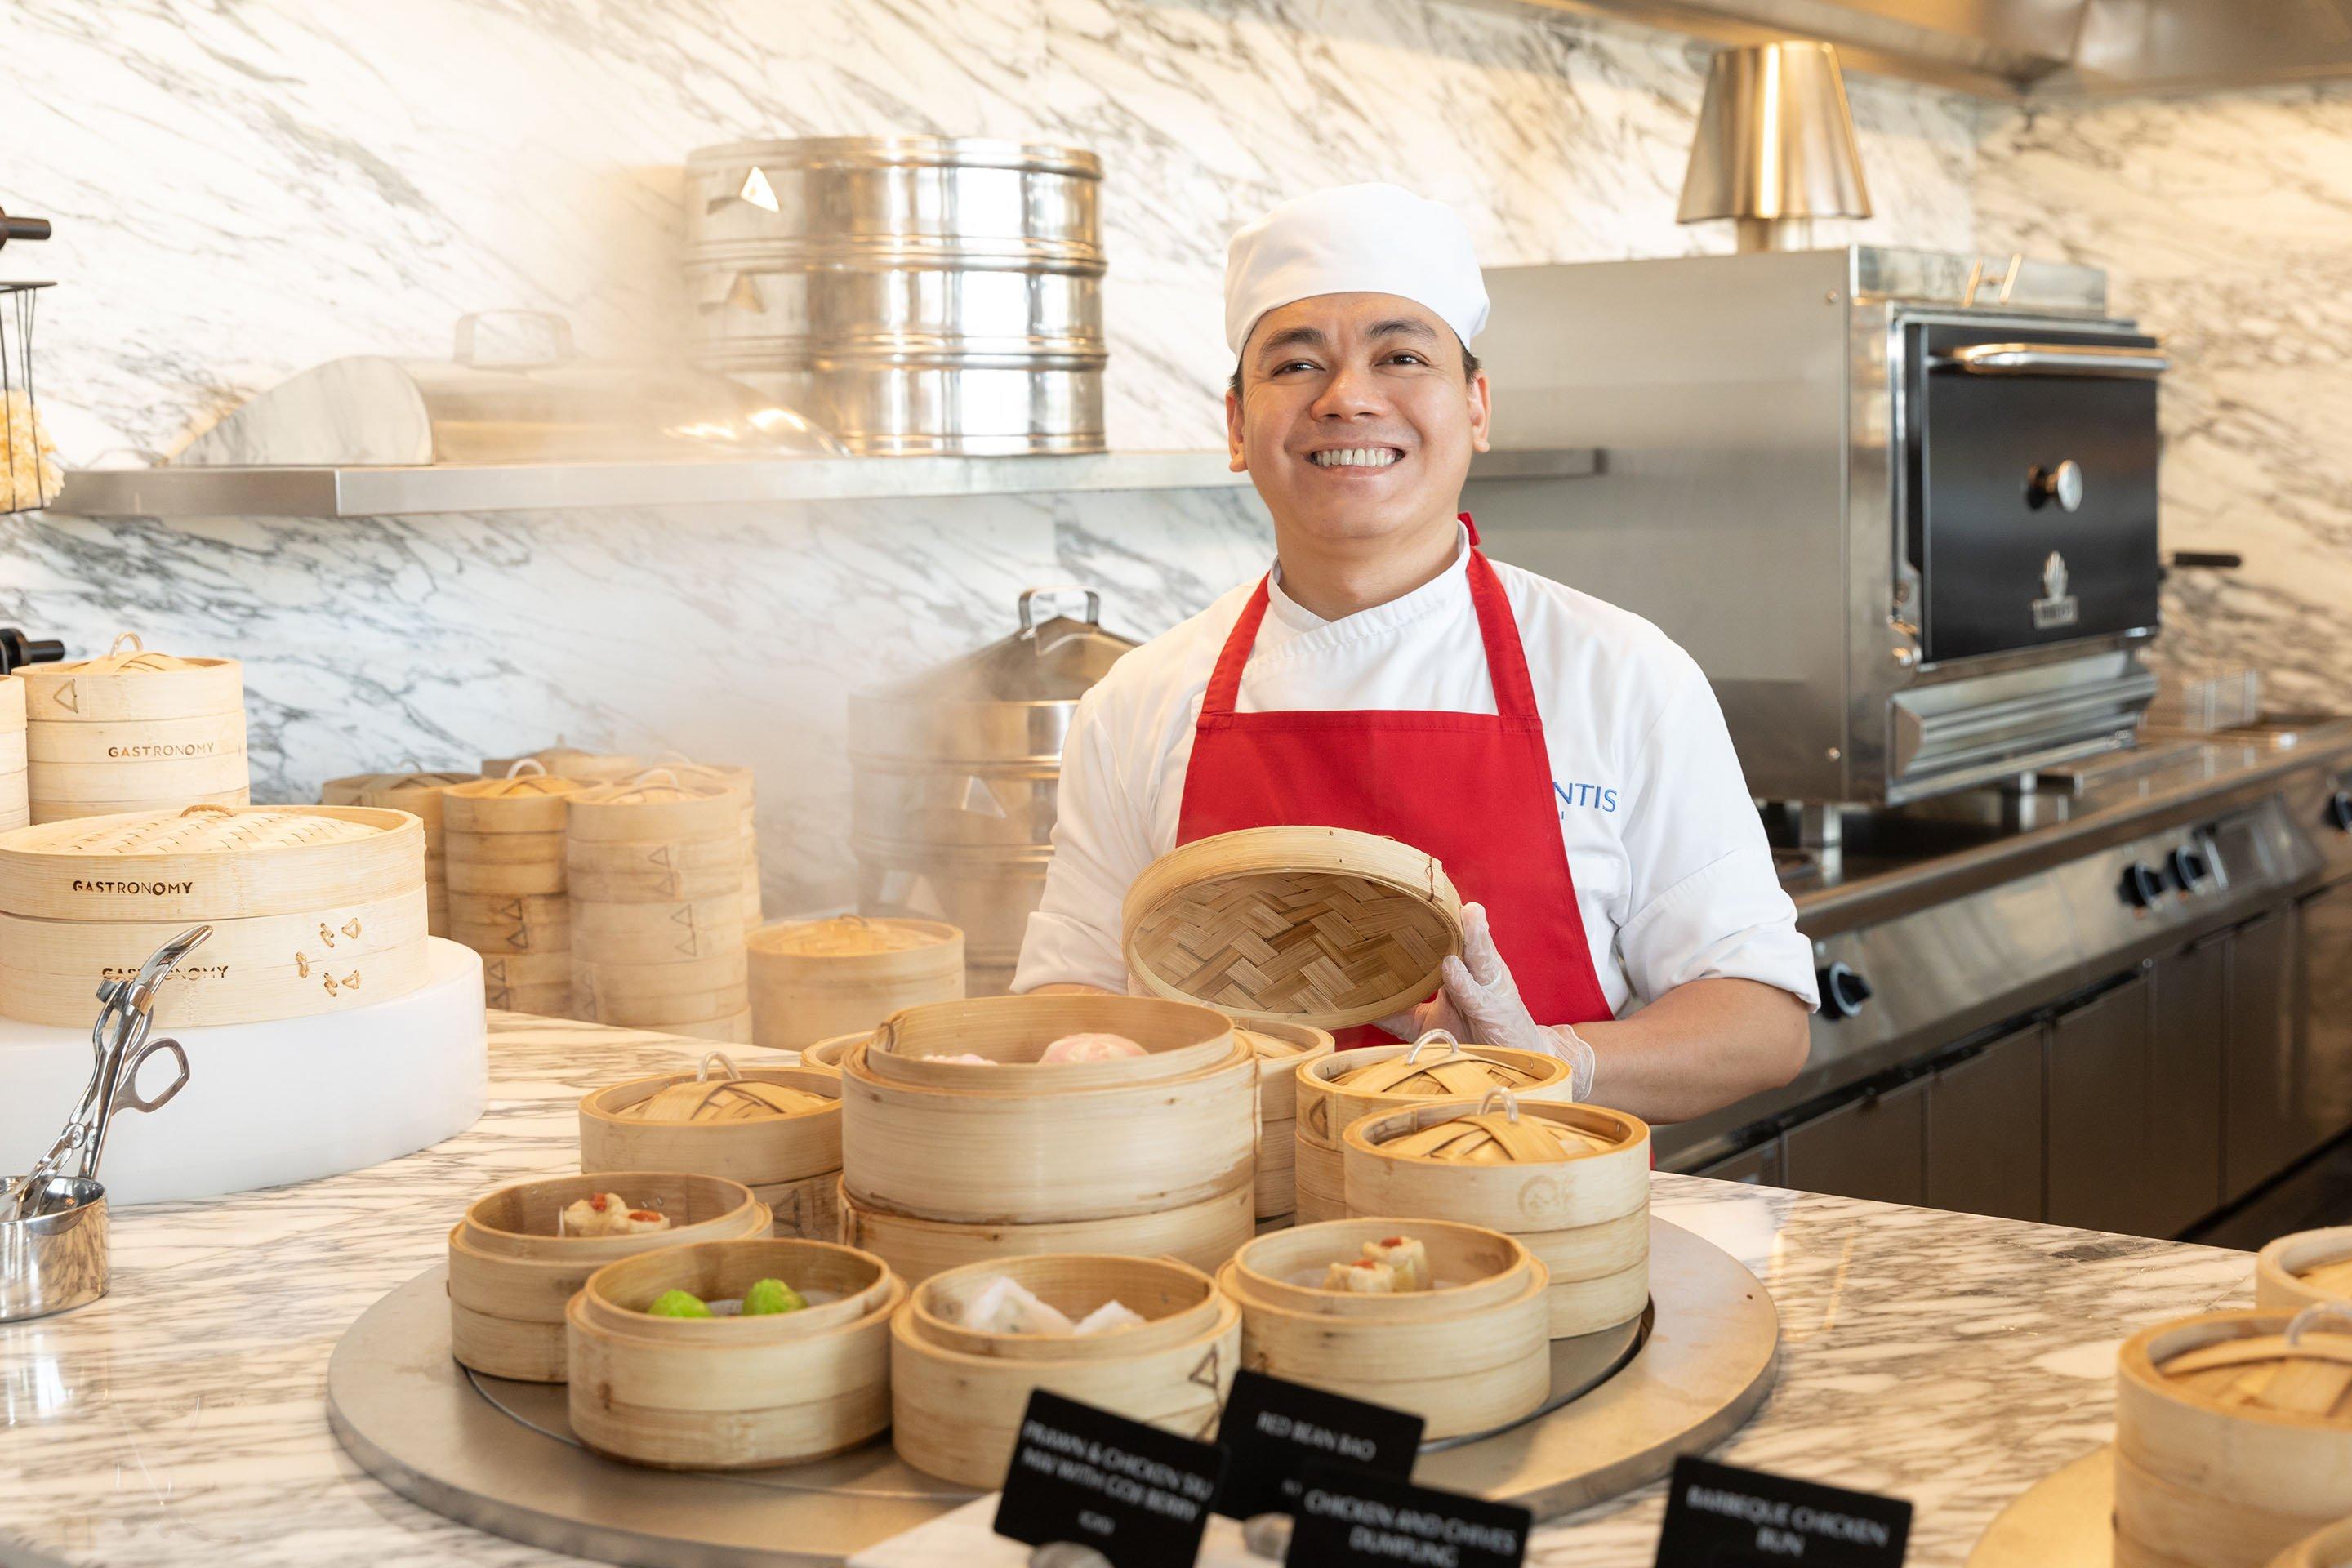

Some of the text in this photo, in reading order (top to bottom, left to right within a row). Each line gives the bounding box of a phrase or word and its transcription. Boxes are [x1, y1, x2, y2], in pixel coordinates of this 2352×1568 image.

[108, 742, 215, 758] GASTRONOMY
[73, 880, 194, 895] GASTRONOMY
[102, 966, 229, 981] GASNOMY
[1258, 1413, 1291, 1436] RED
[1294, 1423, 1339, 1450] BEAN
[1024, 1422, 1085, 1457] PRAWN
[1089, 1444, 1101, 1463] &
[1104, 1450, 1181, 1489] CHICKEN
[1058, 1461, 1104, 1488] WITH
[1147, 1490, 1200, 1521] BERRY
[1306, 1490, 1516, 1555] CHICKEN AND CHIVES
[1793, 1508, 1888, 1546] CHICKEN
[1350, 1526, 1458, 1568] DUMPLING
[1757, 1528, 1804, 1556] BUN
